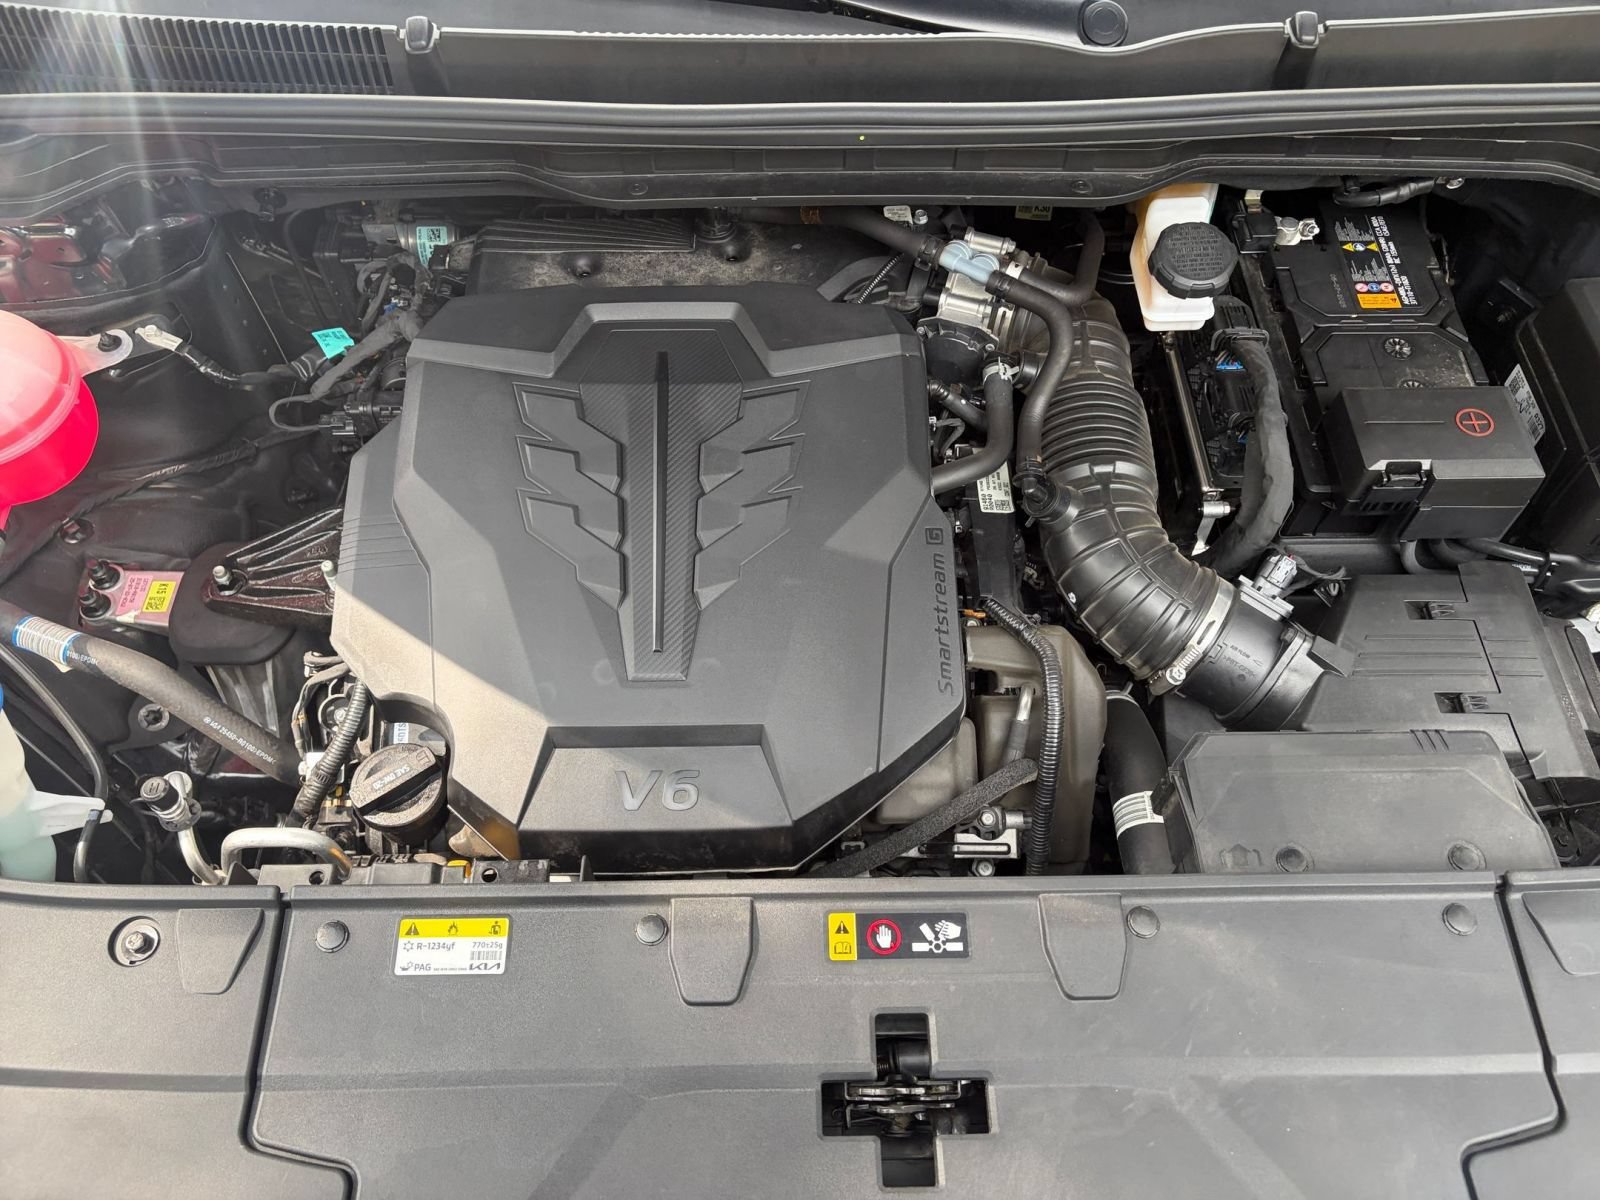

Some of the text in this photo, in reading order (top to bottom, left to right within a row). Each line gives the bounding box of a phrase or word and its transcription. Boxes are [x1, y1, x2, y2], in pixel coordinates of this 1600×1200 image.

[933, 553, 954, 697] Smartstream
[372, 764, 411, 790] SAE 0W-20
[615, 769, 700, 812] V6
[416, 941, 456, 952] R-1234yf
[414, 963, 432, 972] PAG
